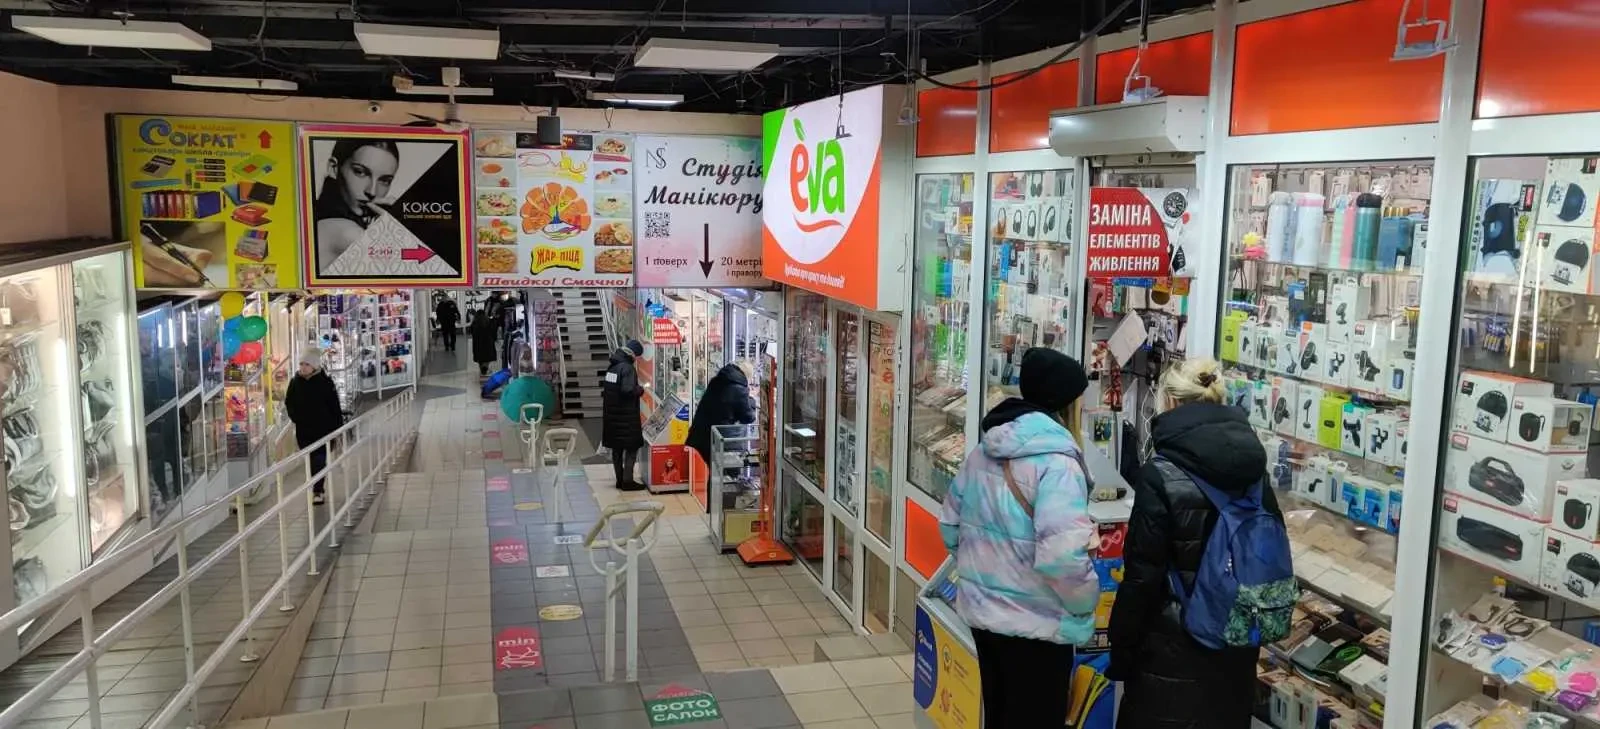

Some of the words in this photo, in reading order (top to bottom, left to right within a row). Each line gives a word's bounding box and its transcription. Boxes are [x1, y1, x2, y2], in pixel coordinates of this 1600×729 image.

[644, 185, 763, 214] Манікюру
[402, 202, 453, 213] КОКОС
[1091, 204, 1152, 226] ЗАМІНА
[1089, 233, 1161, 249] ЕЛЕМЕНТІВ
[645, 256, 650, 266] 1
[653, 257, 688, 270] поверх
[721, 256, 733, 266] 20
[1088, 256, 1160, 272] ЖИВЛЕННЯ
[482, 276, 556, 286] Швидко!
[561, 277, 630, 287] Смачно!
[499, 637, 535, 647] min
[651, 699, 711, 712] ФОТО
[653, 708, 718, 722] САЛОН
